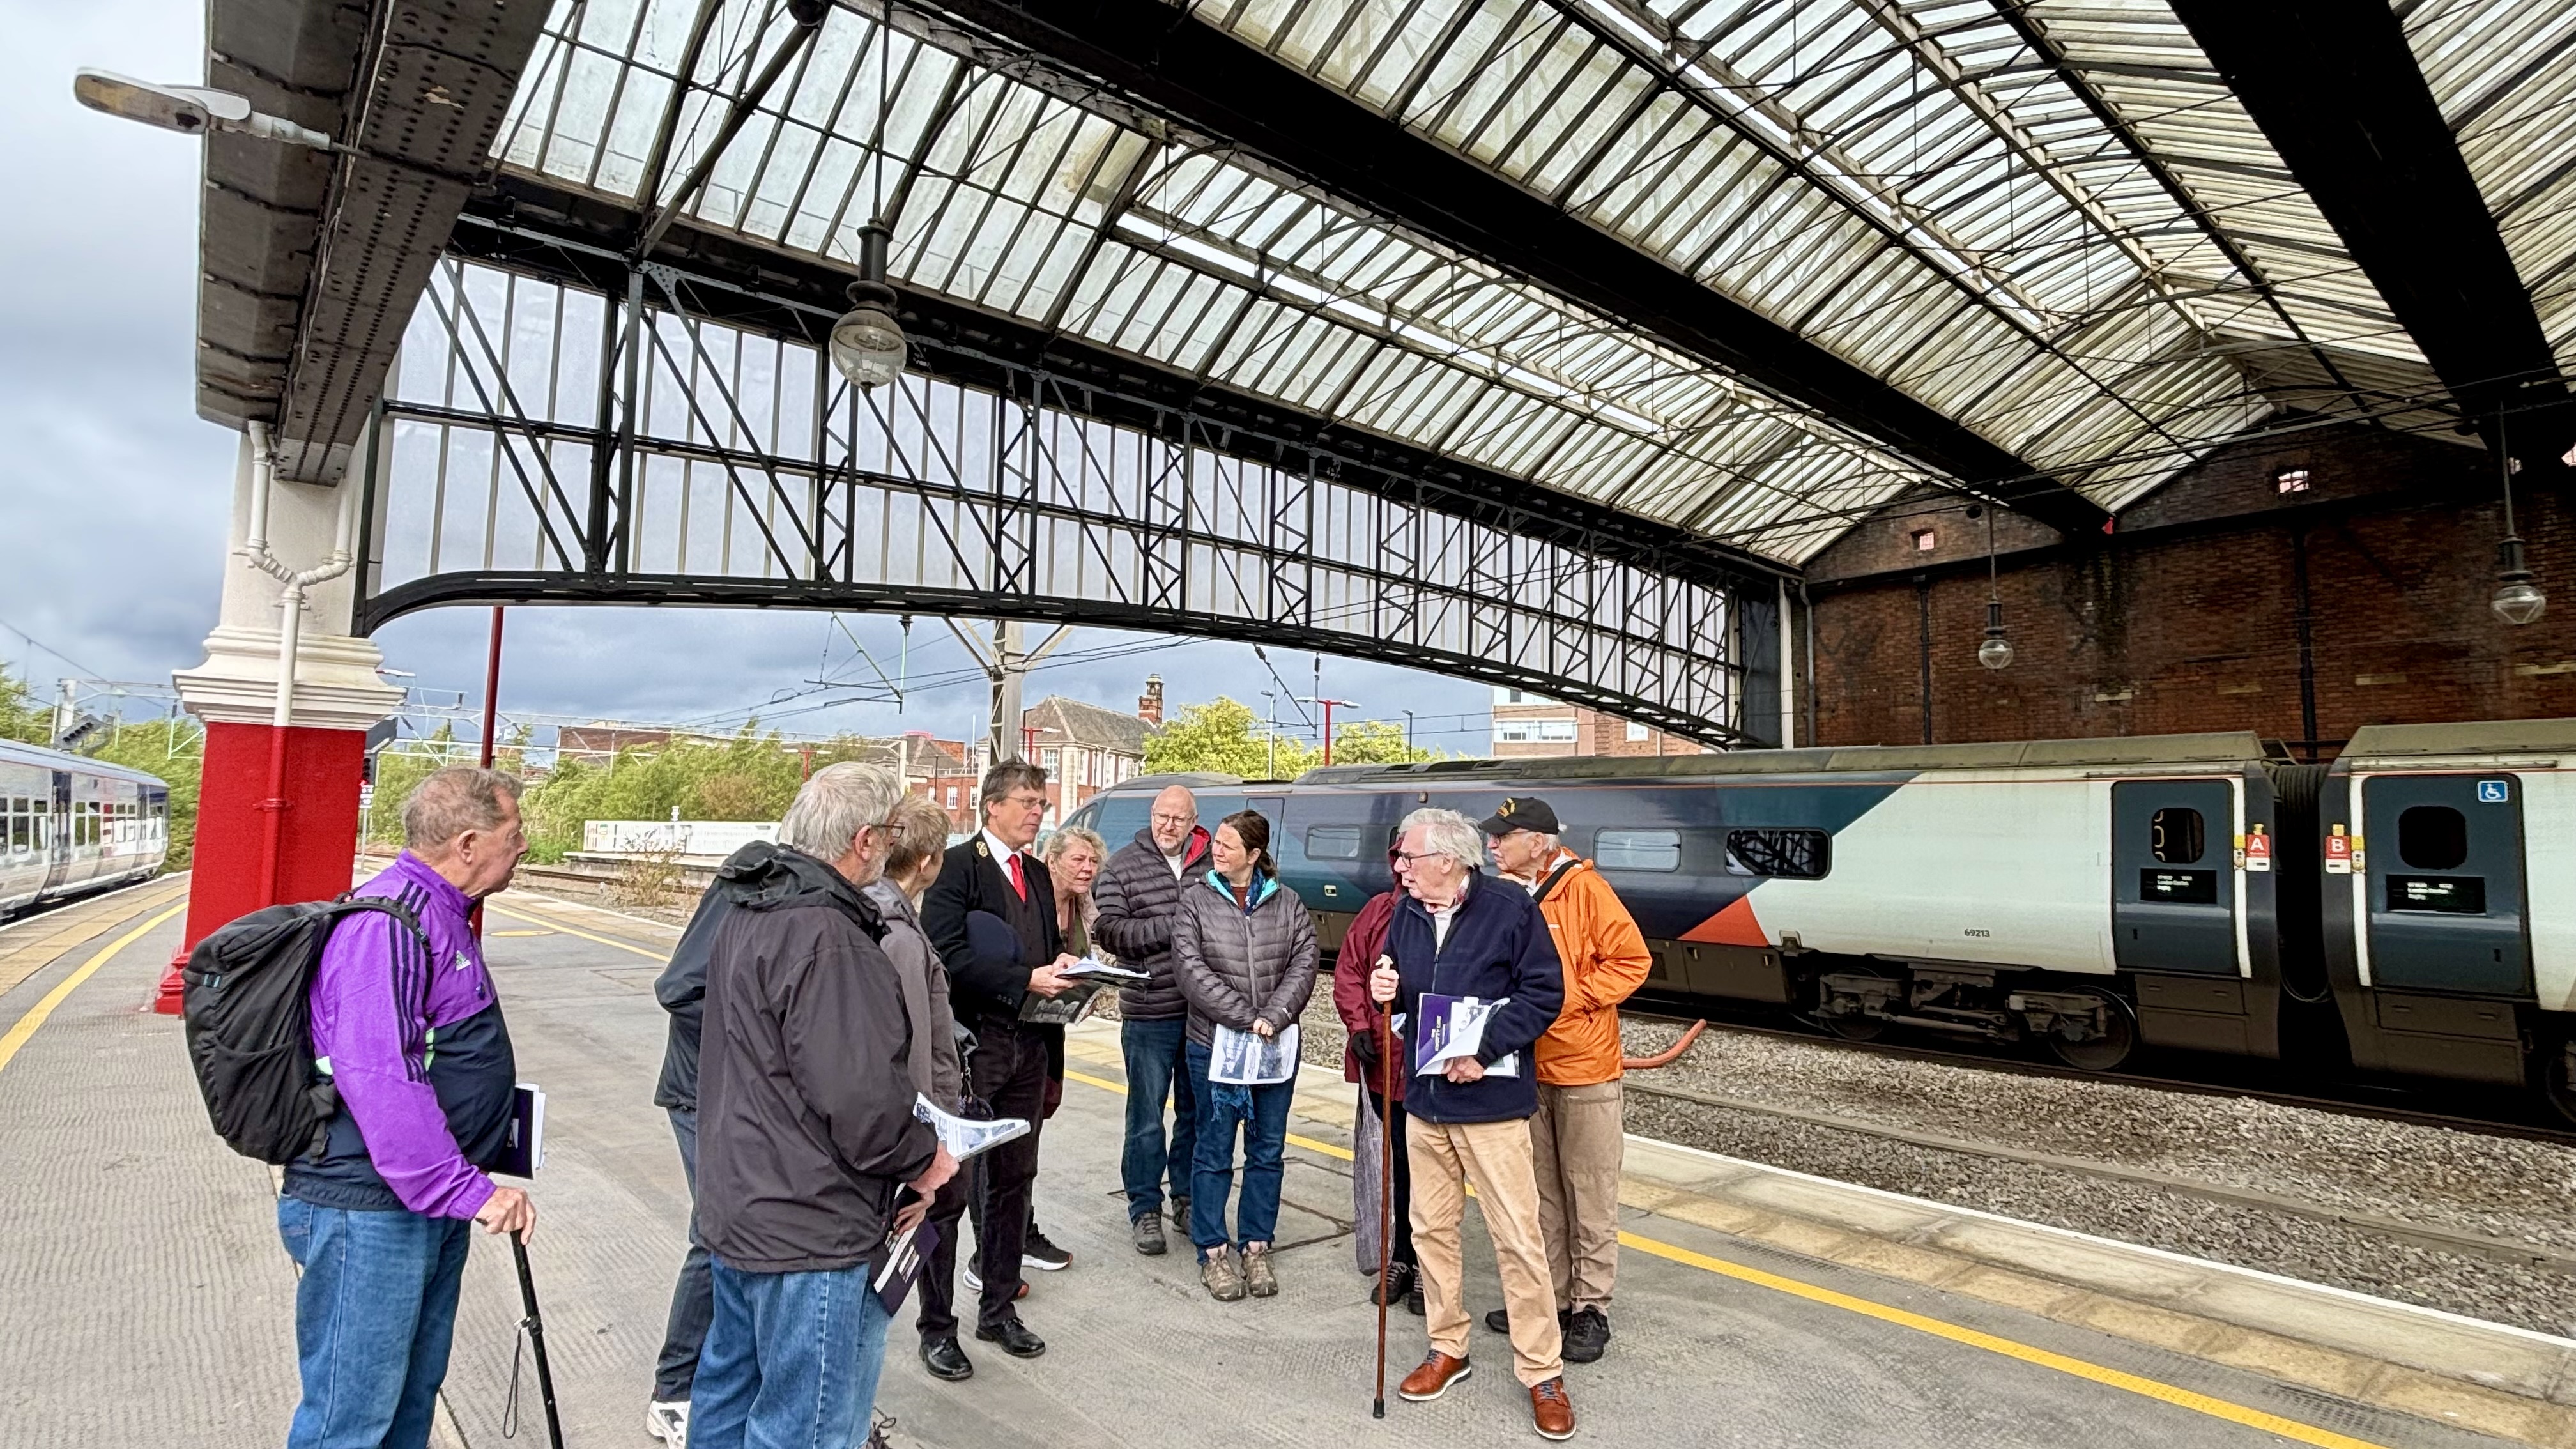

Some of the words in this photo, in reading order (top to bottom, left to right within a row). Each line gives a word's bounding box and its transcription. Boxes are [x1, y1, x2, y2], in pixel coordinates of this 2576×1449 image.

[2250, 838, 2264, 850] A
[2331, 838, 2345, 852] B
[1964, 928, 1990, 937] 69213
